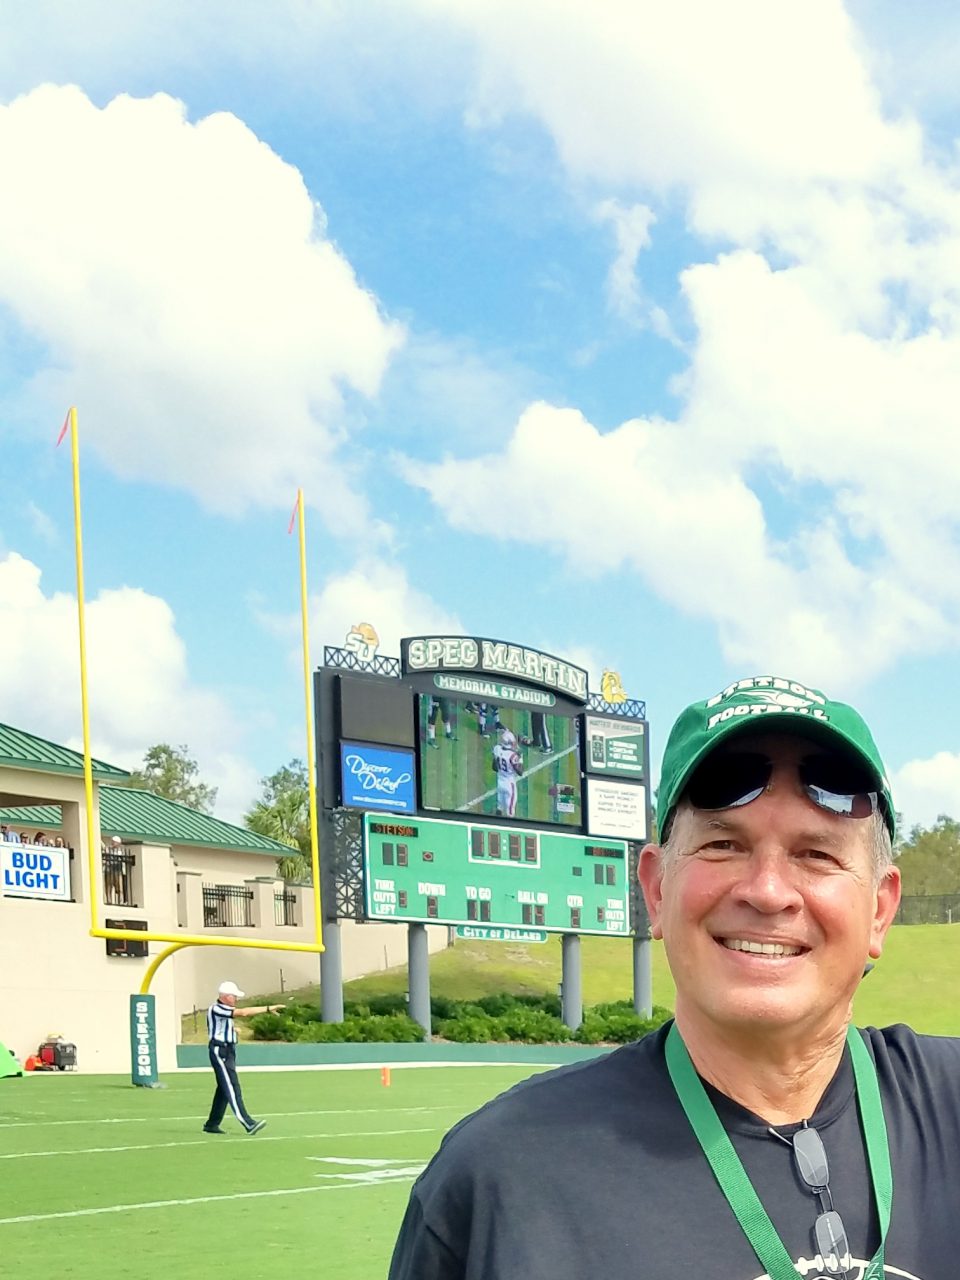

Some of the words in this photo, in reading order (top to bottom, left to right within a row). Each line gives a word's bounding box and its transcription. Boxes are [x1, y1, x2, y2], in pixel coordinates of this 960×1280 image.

[409, 639, 478, 669] SPEC
[482, 641, 587, 699] MARTIN
[439, 676, 498, 695] MEMORIAL
[501, 686, 551, 705] STADIUM
[12, 852, 52, 871] BUD
[5, 869, 60, 889] LIGHT
[374, 879, 395, 891] TIME
[418, 882, 446, 896] DOWN
[465, 886, 478, 900] TO
[478, 888, 492, 901] GO
[373, 891, 397, 904] OUTS
[567, 894, 583, 907] QTR
[375, 903, 396, 915] LEFT
[605, 909, 625, 921] OUTS
[606, 920, 625, 931] LEFT
[135, 1001, 152, 1076] STETSON
